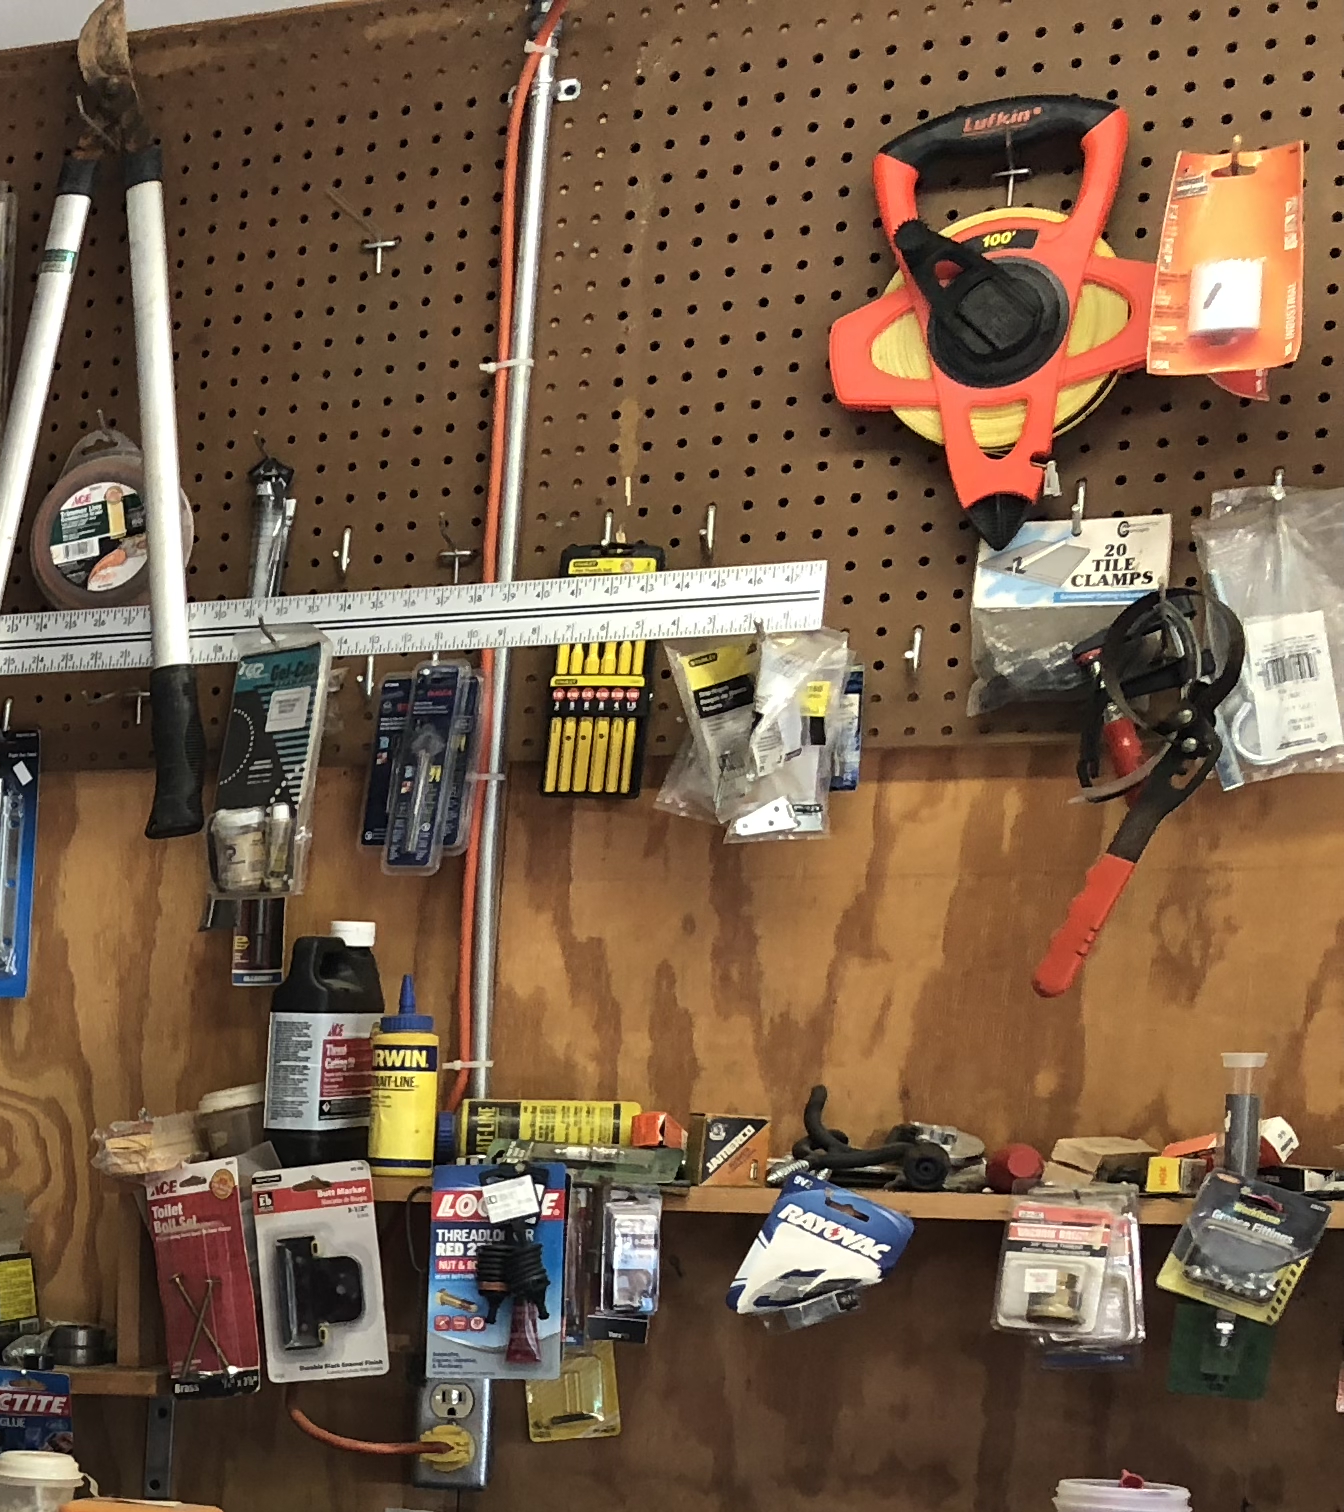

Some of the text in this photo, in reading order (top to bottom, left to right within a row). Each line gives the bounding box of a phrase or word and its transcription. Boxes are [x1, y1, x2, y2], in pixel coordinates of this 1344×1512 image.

[962, 110, 1031, 133] Lufkin
[982, 230, 1017, 248] 100'
[71, 492, 92, 507] ACE
[1104, 543, 1128, 557] 20
[1092, 557, 1136, 572] TILE
[1070, 570, 1155, 587] CLAMPS
[328, 1023, 345, 1037] ACE
[374, 1050, 427, 1068] RWIN
[150, 1179, 178, 1197] ACE
[317, 1185, 368, 1198] Butt Marker
[151, 1202, 184, 1220] Toilet
[153, 1216, 179, 1234] Bolt
[777, 1203, 892, 1261] RAYOVAC
[435, 1243, 464, 1256] RED
[439, 1261, 456, 1270] NUT
[174, 1382, 200, 1394] Brass
[0, 1417, 26, 1428] GLUE
